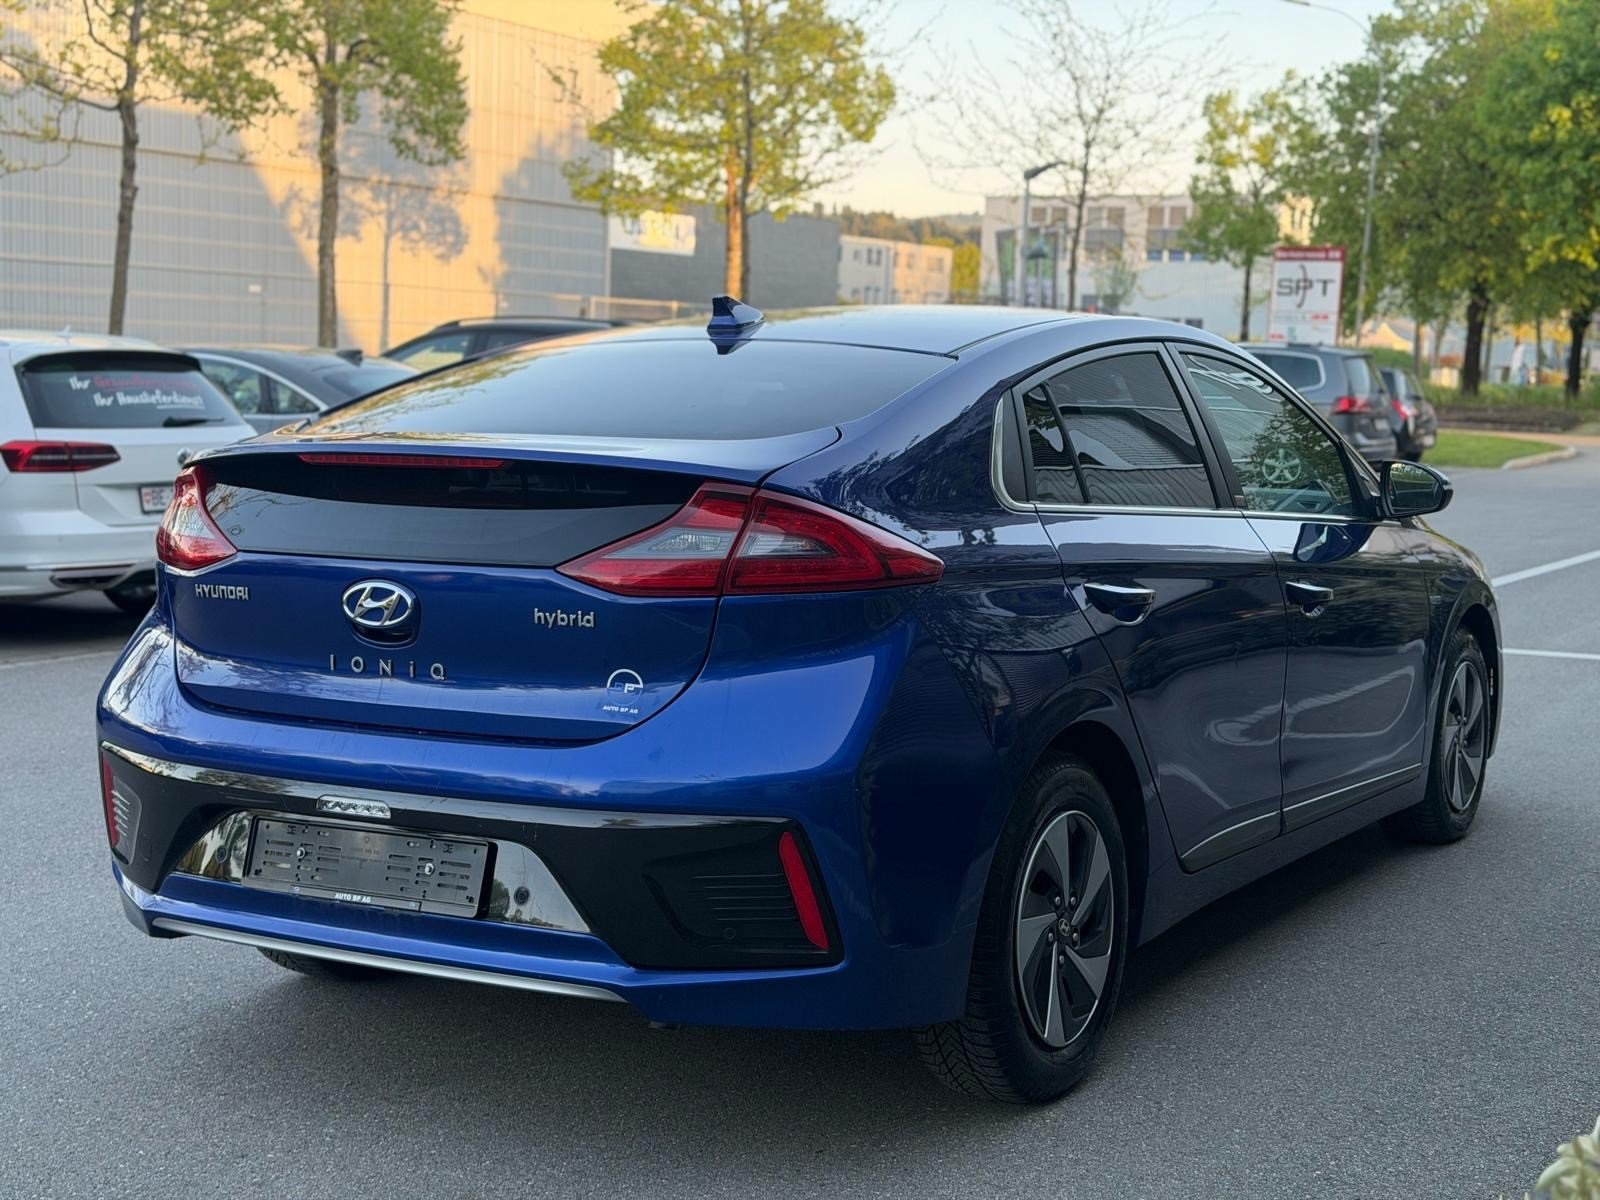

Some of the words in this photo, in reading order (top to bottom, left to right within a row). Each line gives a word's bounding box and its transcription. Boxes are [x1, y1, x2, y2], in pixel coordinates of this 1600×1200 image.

[194, 583, 249, 600] HYUNDAI
[533, 607, 595, 629] hybrid
[329, 654, 447, 681] IONIQ
[602, 704, 619, 712] AUTO
[334, 892, 351, 901] AUTO
[361, 896, 371, 904] AG
